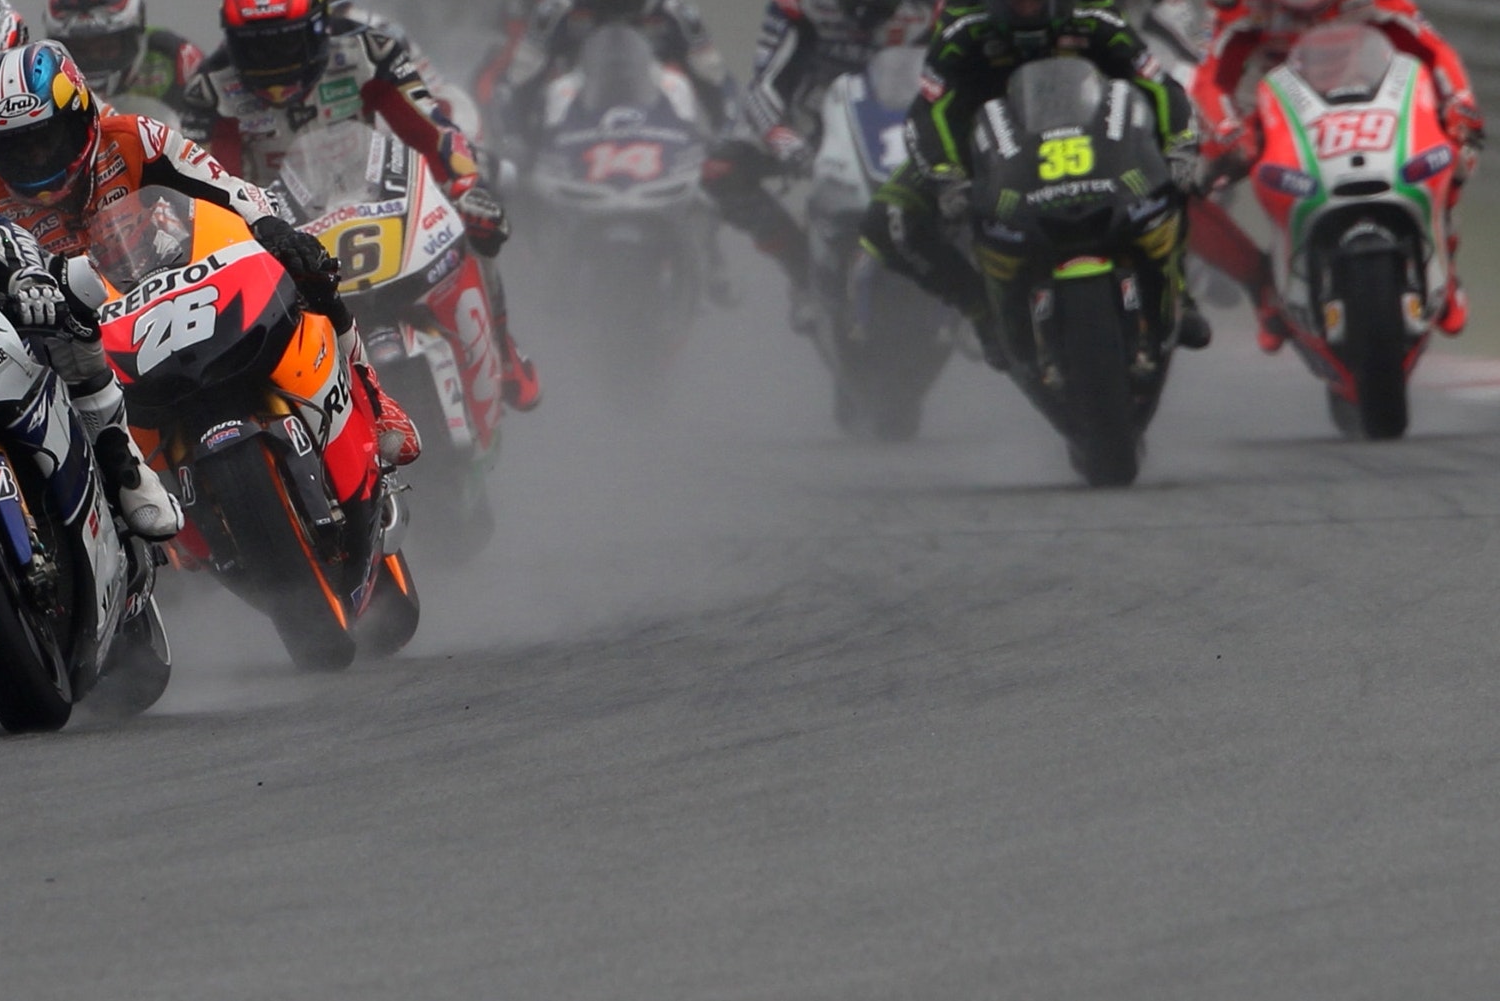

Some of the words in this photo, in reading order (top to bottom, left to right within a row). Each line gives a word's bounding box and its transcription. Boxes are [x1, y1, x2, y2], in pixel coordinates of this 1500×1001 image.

[1, 96, 36, 113] Arai
[583, 139, 665, 183] 14
[1038, 135, 1095, 182] 35
[337, 224, 382, 285] 6
[100, 254, 227, 325] REPSOL
[132, 284, 220, 377] 26
[200, 419, 244, 443] REPSOL
